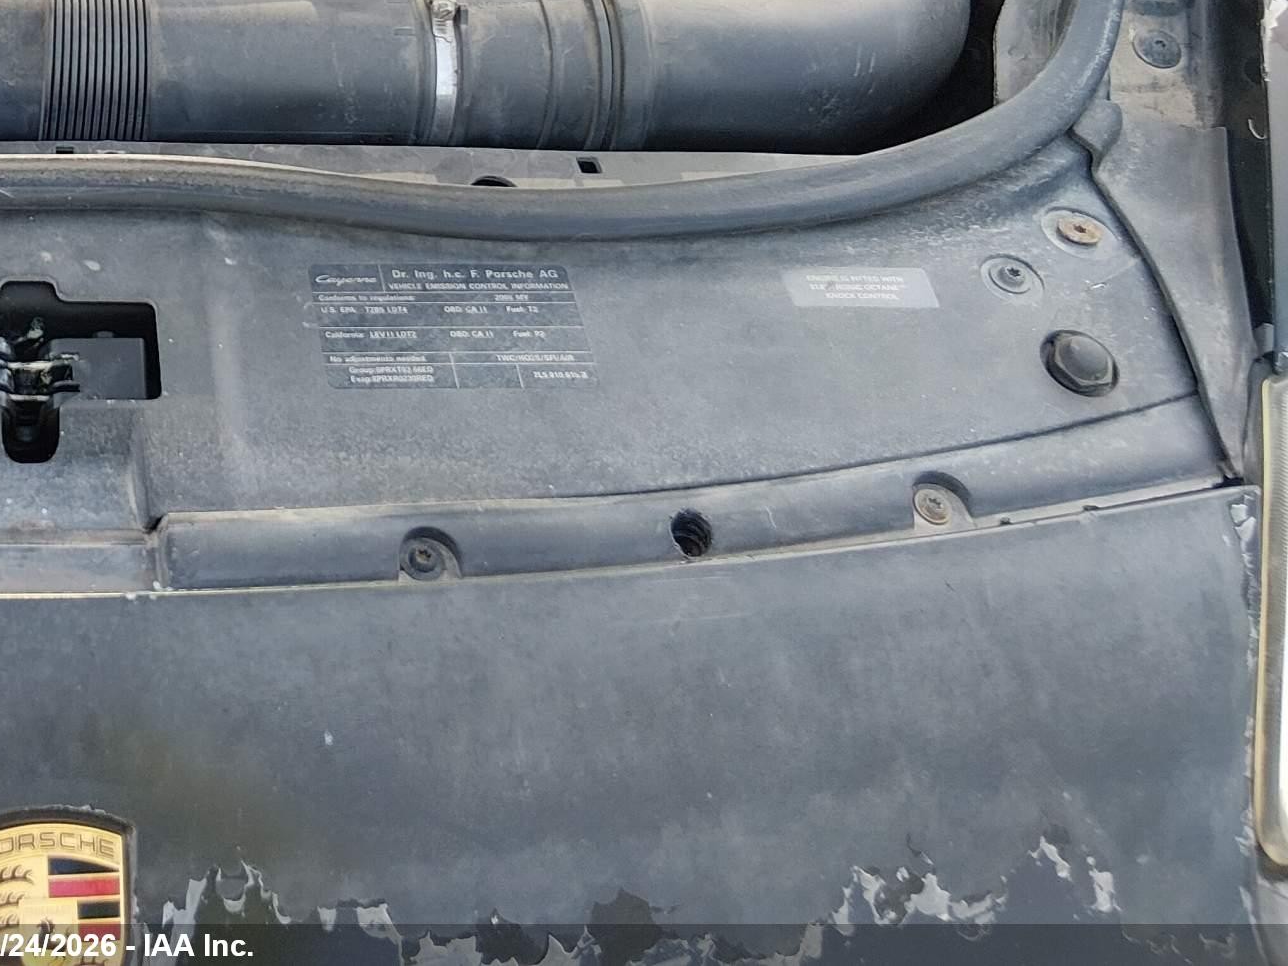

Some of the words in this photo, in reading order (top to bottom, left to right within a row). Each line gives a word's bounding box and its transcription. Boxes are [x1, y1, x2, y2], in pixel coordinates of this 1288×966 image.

[392, 269, 408, 278] Dr.
[414, 269, 437, 280] Ing.
[443, 269, 465, 278] h.c.
[470, 269, 480, 278] F.
[485, 269, 533, 278] Porsche
[539, 269, 558, 278] AG
